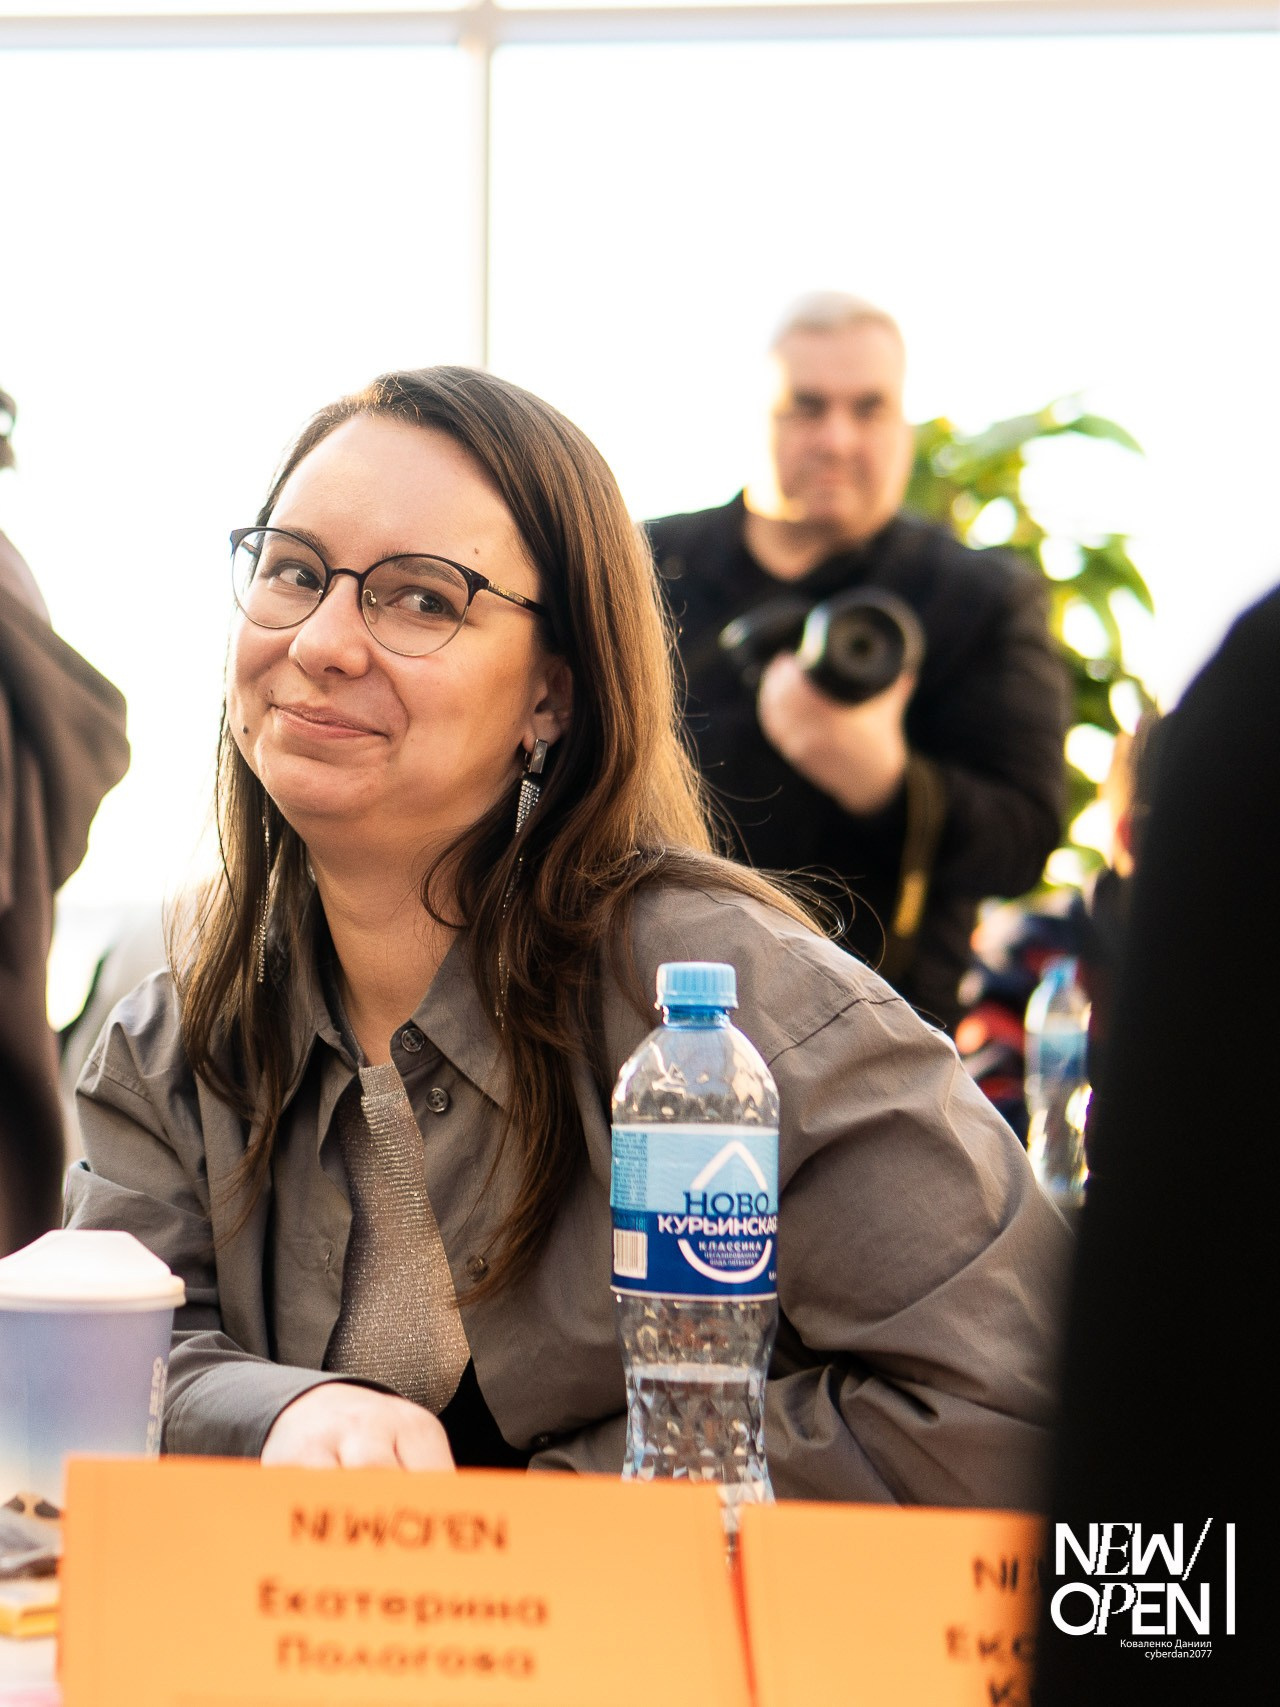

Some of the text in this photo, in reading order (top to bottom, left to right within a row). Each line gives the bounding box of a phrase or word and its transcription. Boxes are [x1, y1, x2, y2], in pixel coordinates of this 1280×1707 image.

[683, 1191, 769, 1215] НОВО
[658, 1214, 777, 1236] КУРЬИНСКАЯ
[699, 1241, 762, 1252] КЛАССИКА
[258, 1576, 548, 1628] Екатерина
[276, 1631, 537, 1680] Пологова
